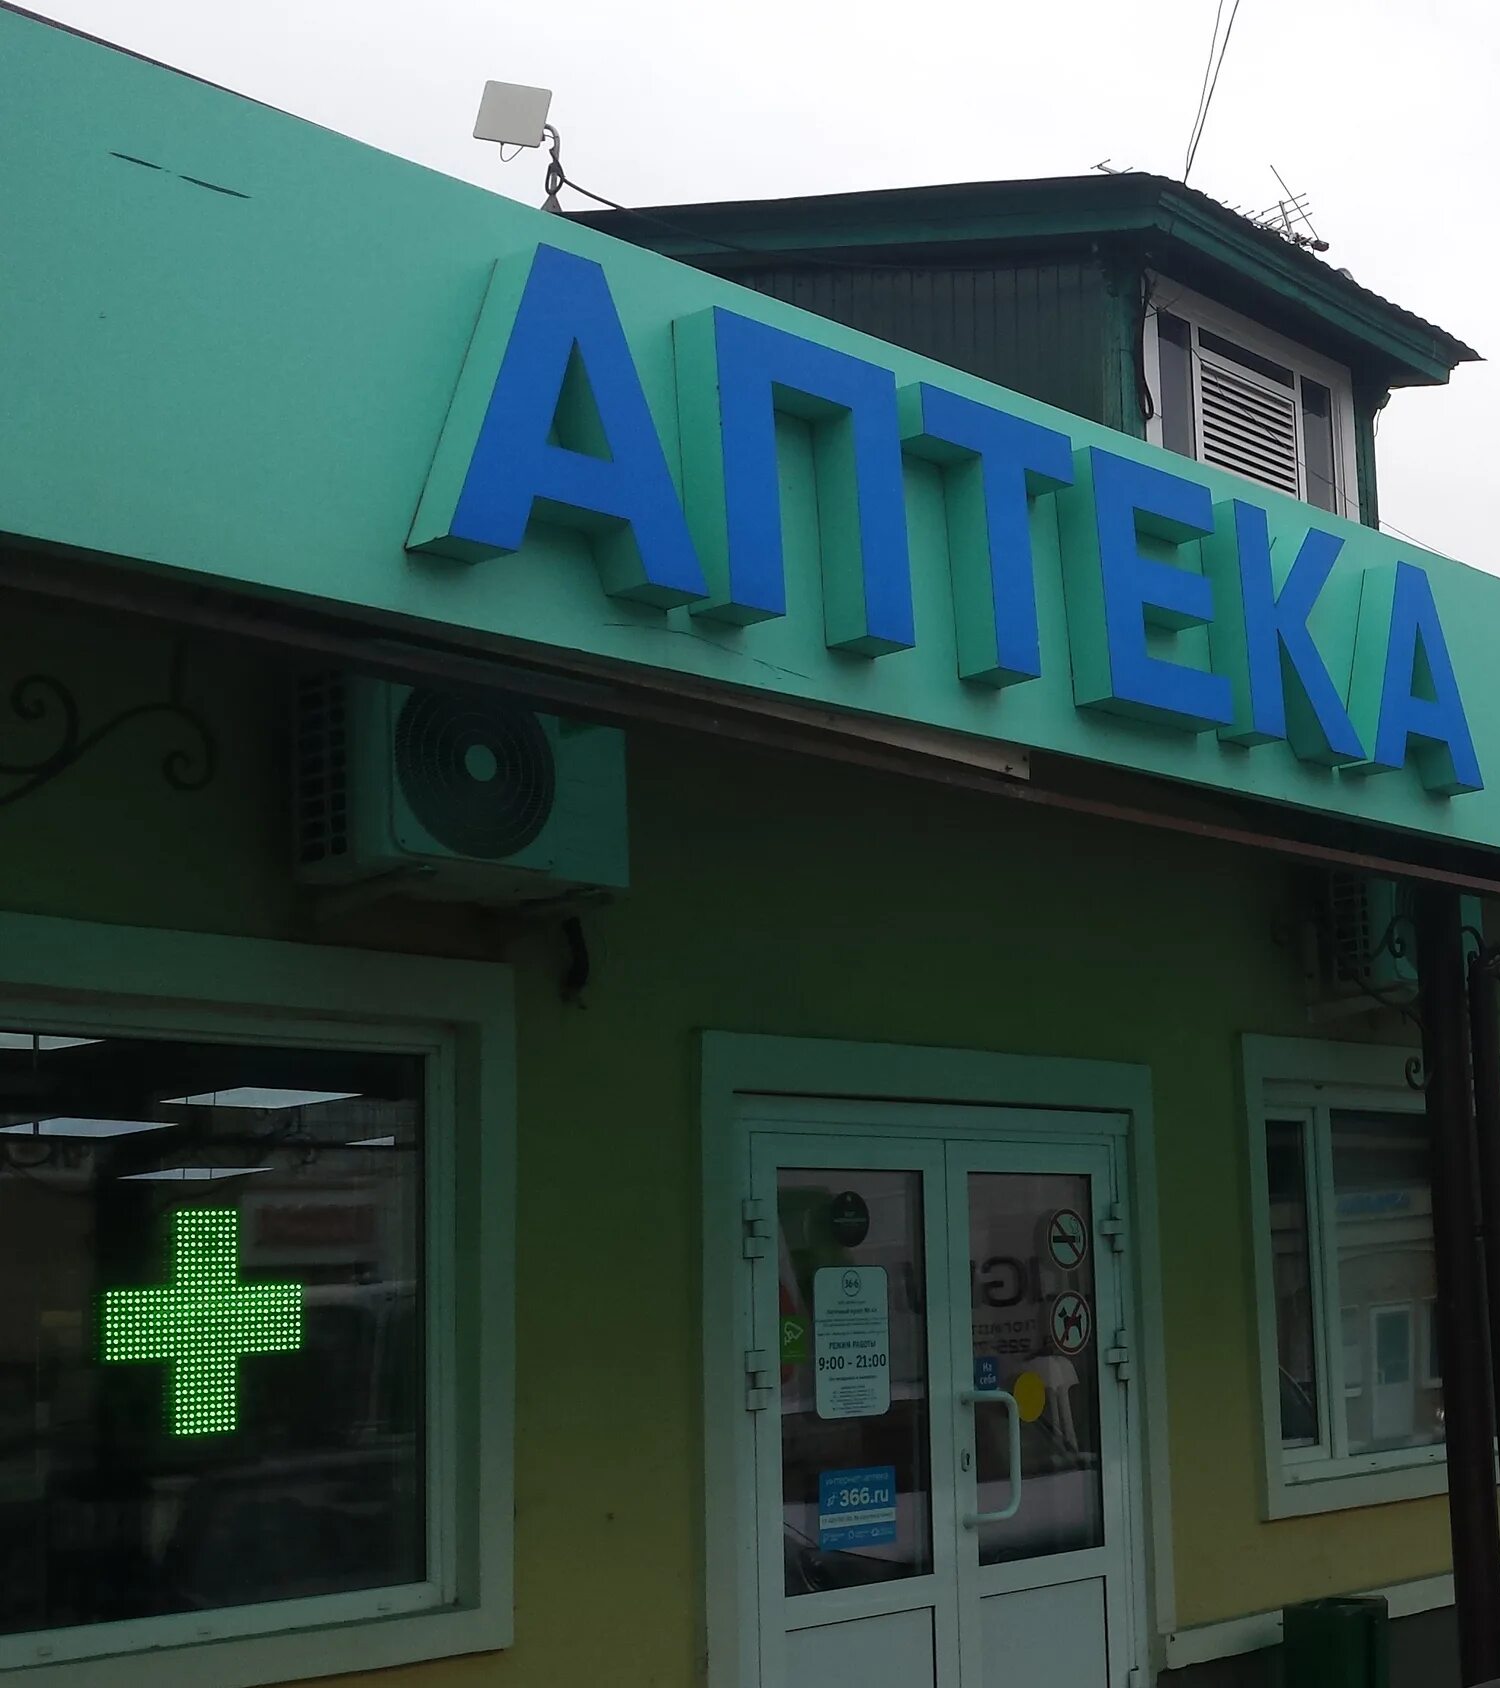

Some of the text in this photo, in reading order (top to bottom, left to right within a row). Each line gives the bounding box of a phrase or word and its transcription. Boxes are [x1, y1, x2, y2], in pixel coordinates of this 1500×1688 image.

[449, 242, 1484, 796] АПТЕКА
[818, 1356, 845, 1371] 9:00
[856, 1353, 887, 1368] 21:00
[839, 1487, 889, 1507] 366.ru
